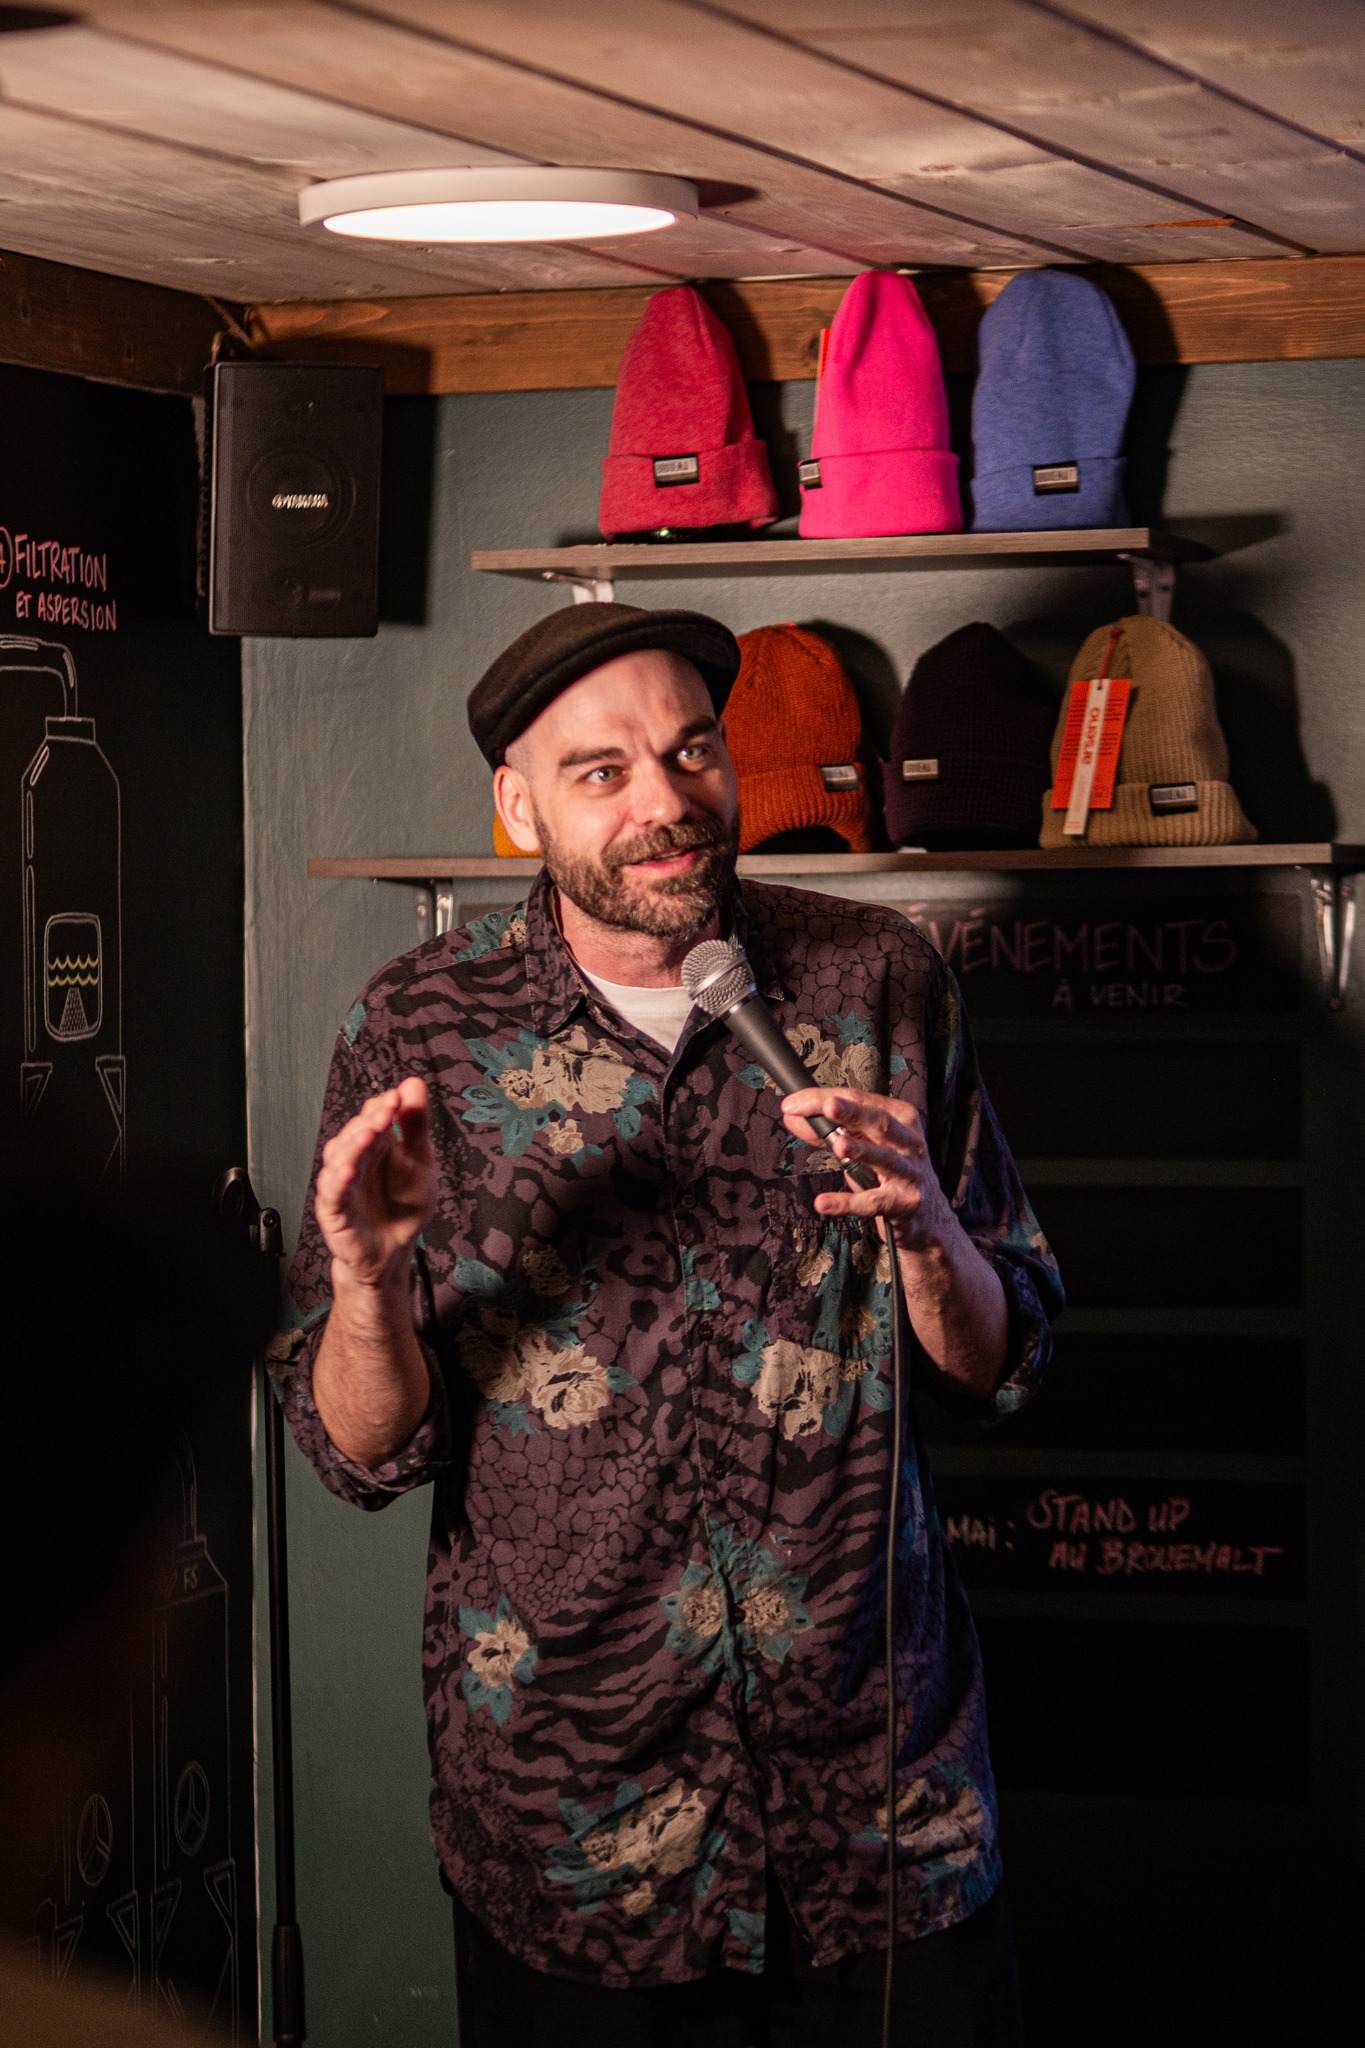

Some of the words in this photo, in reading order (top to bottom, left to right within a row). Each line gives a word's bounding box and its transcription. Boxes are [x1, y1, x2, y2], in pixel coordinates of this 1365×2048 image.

[15, 533, 108, 592] FILTRATION
[16, 589, 33, 619] ET
[37, 591, 117, 632] ASPERSION
[1090, 979, 1188, 1009] VENIR
[1025, 1488, 1137, 1535] STAND
[1147, 1495, 1192, 1534] UP
[1048, 1539, 1089, 1573] AU
